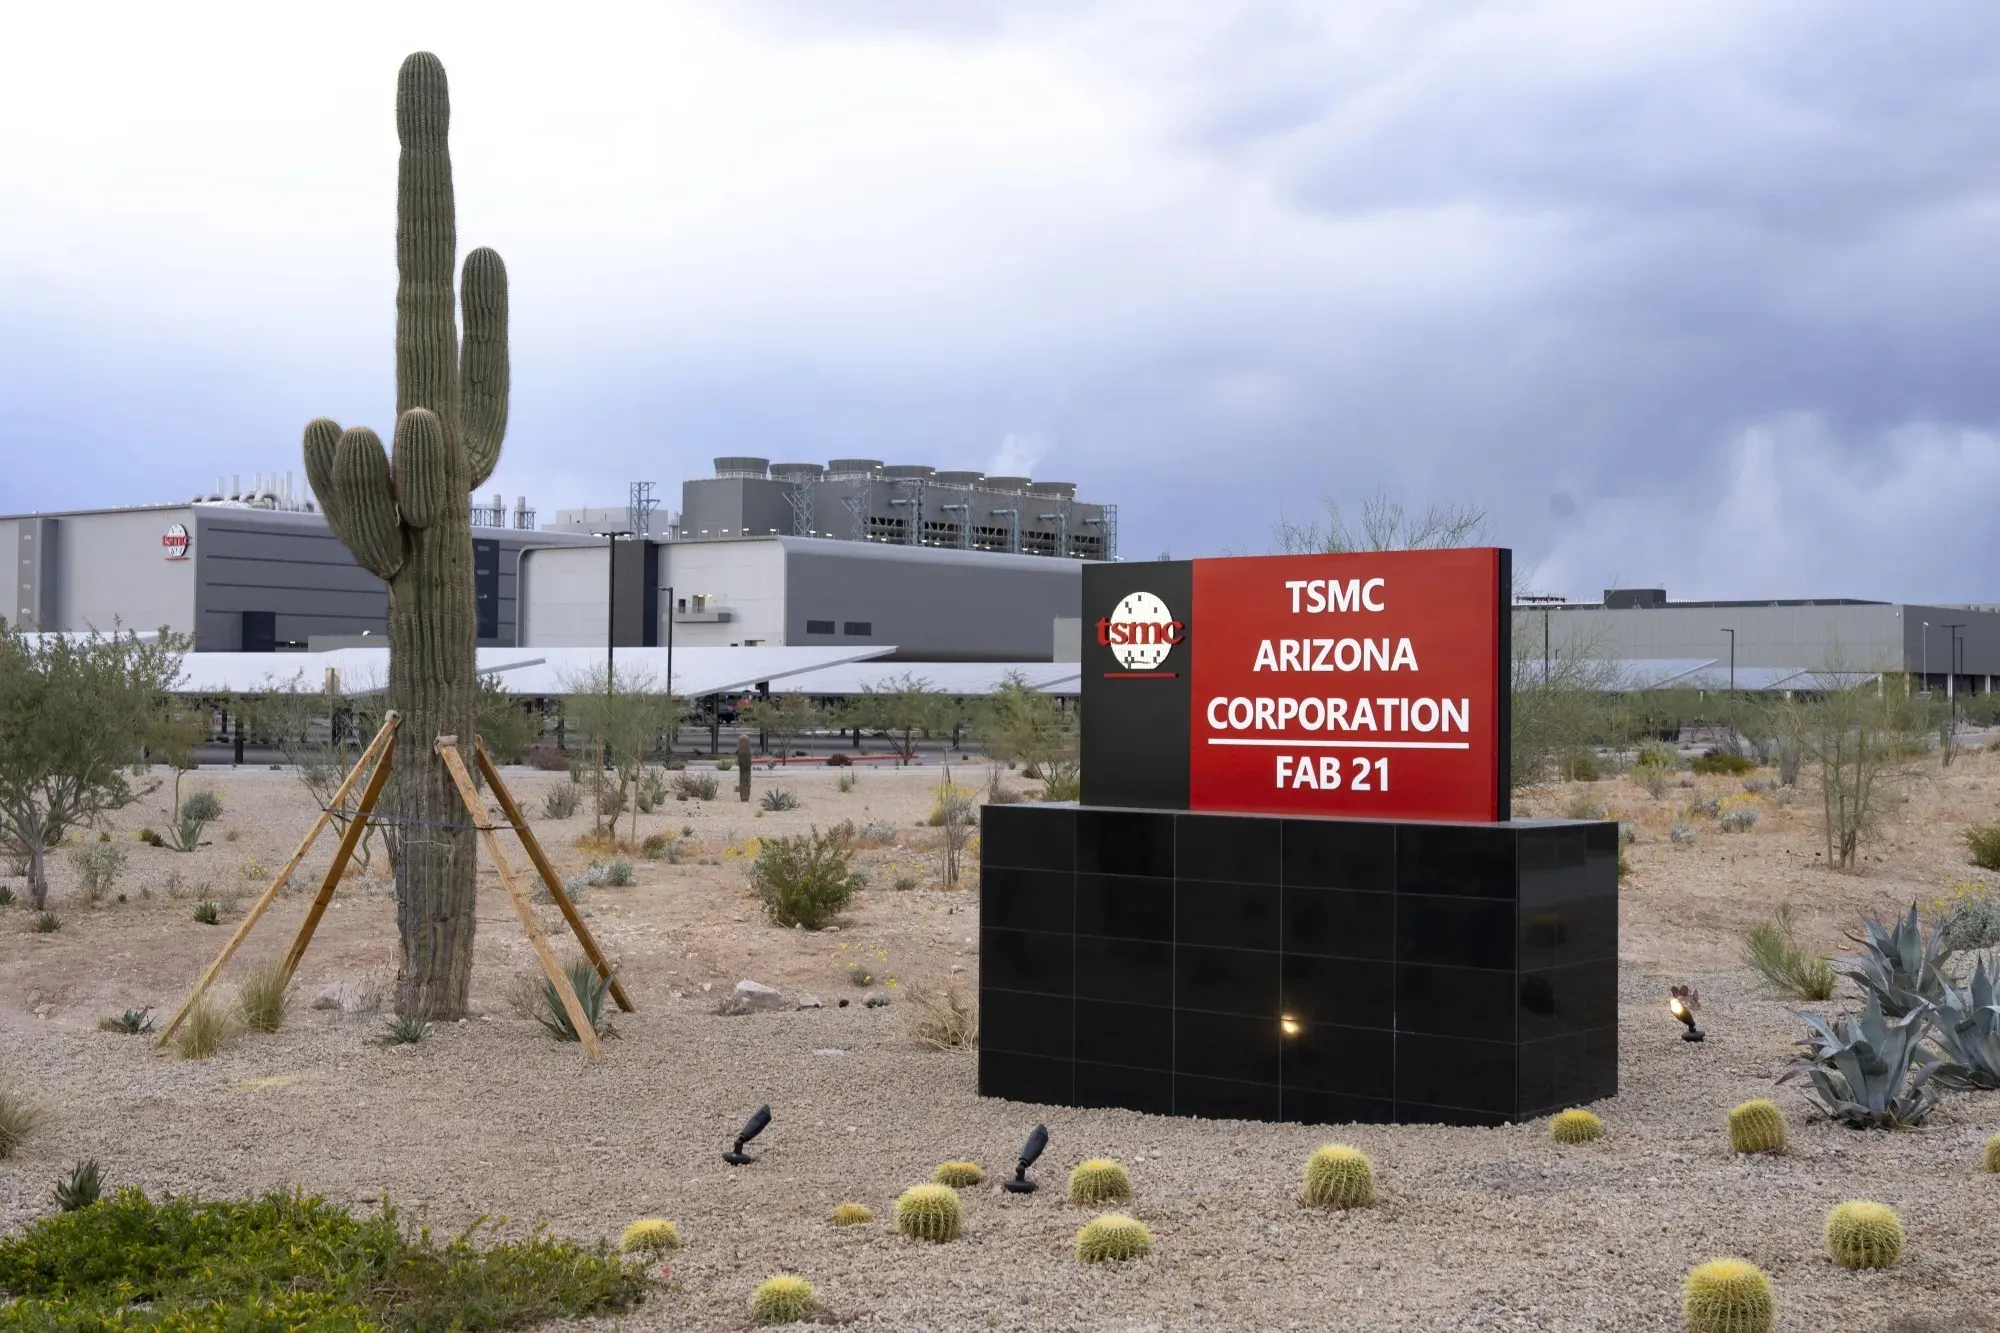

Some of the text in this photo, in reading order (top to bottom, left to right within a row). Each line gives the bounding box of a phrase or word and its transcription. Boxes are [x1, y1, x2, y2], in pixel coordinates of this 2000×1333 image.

[1286, 578, 1385, 614] TSMC
[1095, 617, 1184, 646] tsmc
[1253, 638, 1419, 672] ARIZONA
[1207, 697, 1470, 733] CORPORATION
[1276, 756, 1388, 792] FAB 21
